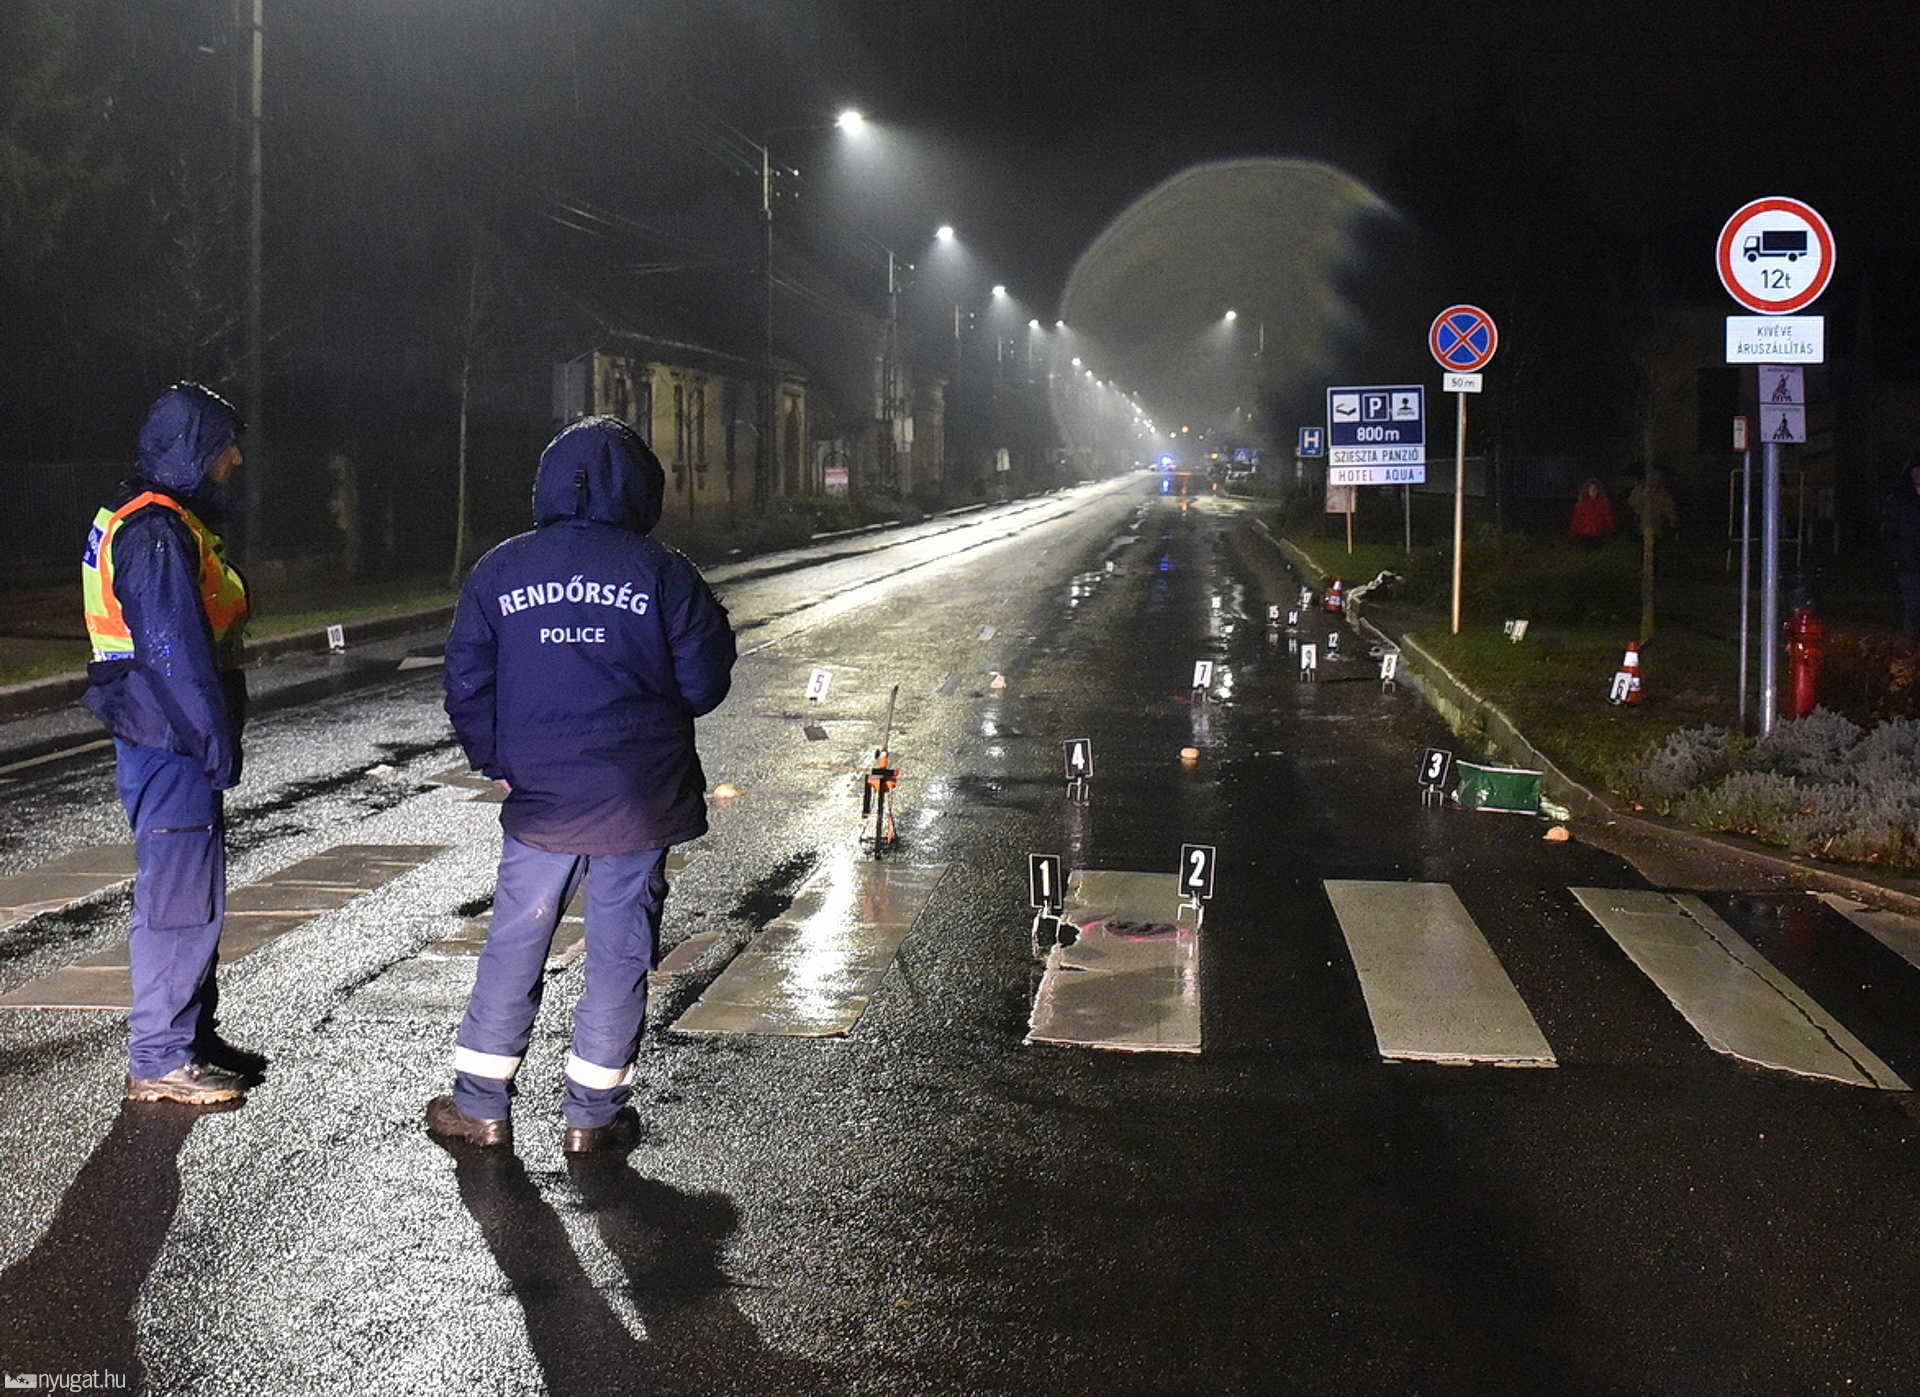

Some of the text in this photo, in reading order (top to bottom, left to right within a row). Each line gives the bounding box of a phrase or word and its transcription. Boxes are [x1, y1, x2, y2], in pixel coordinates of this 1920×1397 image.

[1757, 325, 1793, 337] KIVÉVE
[1736, 338, 1814, 355] ÁRUSZÁLLÍTÁS
[1369, 397, 1382, 418] P
[1303, 430, 1320, 449] H
[1356, 426, 1384, 442] 800
[1333, 447, 1419, 463] SZIESZTA PANZIÓ
[1338, 469, 1415, 482] HOTEL AQUA
[497, 574, 650, 617] RENDŐRSÉG
[539, 627, 606, 644] POLICE
[814, 674, 825, 694] 5
[1071, 742, 1085, 770] 4
[1428, 752, 1443, 779] 3
[1039, 859, 1050, 897] 1
[1188, 850, 1206, 887] 2
